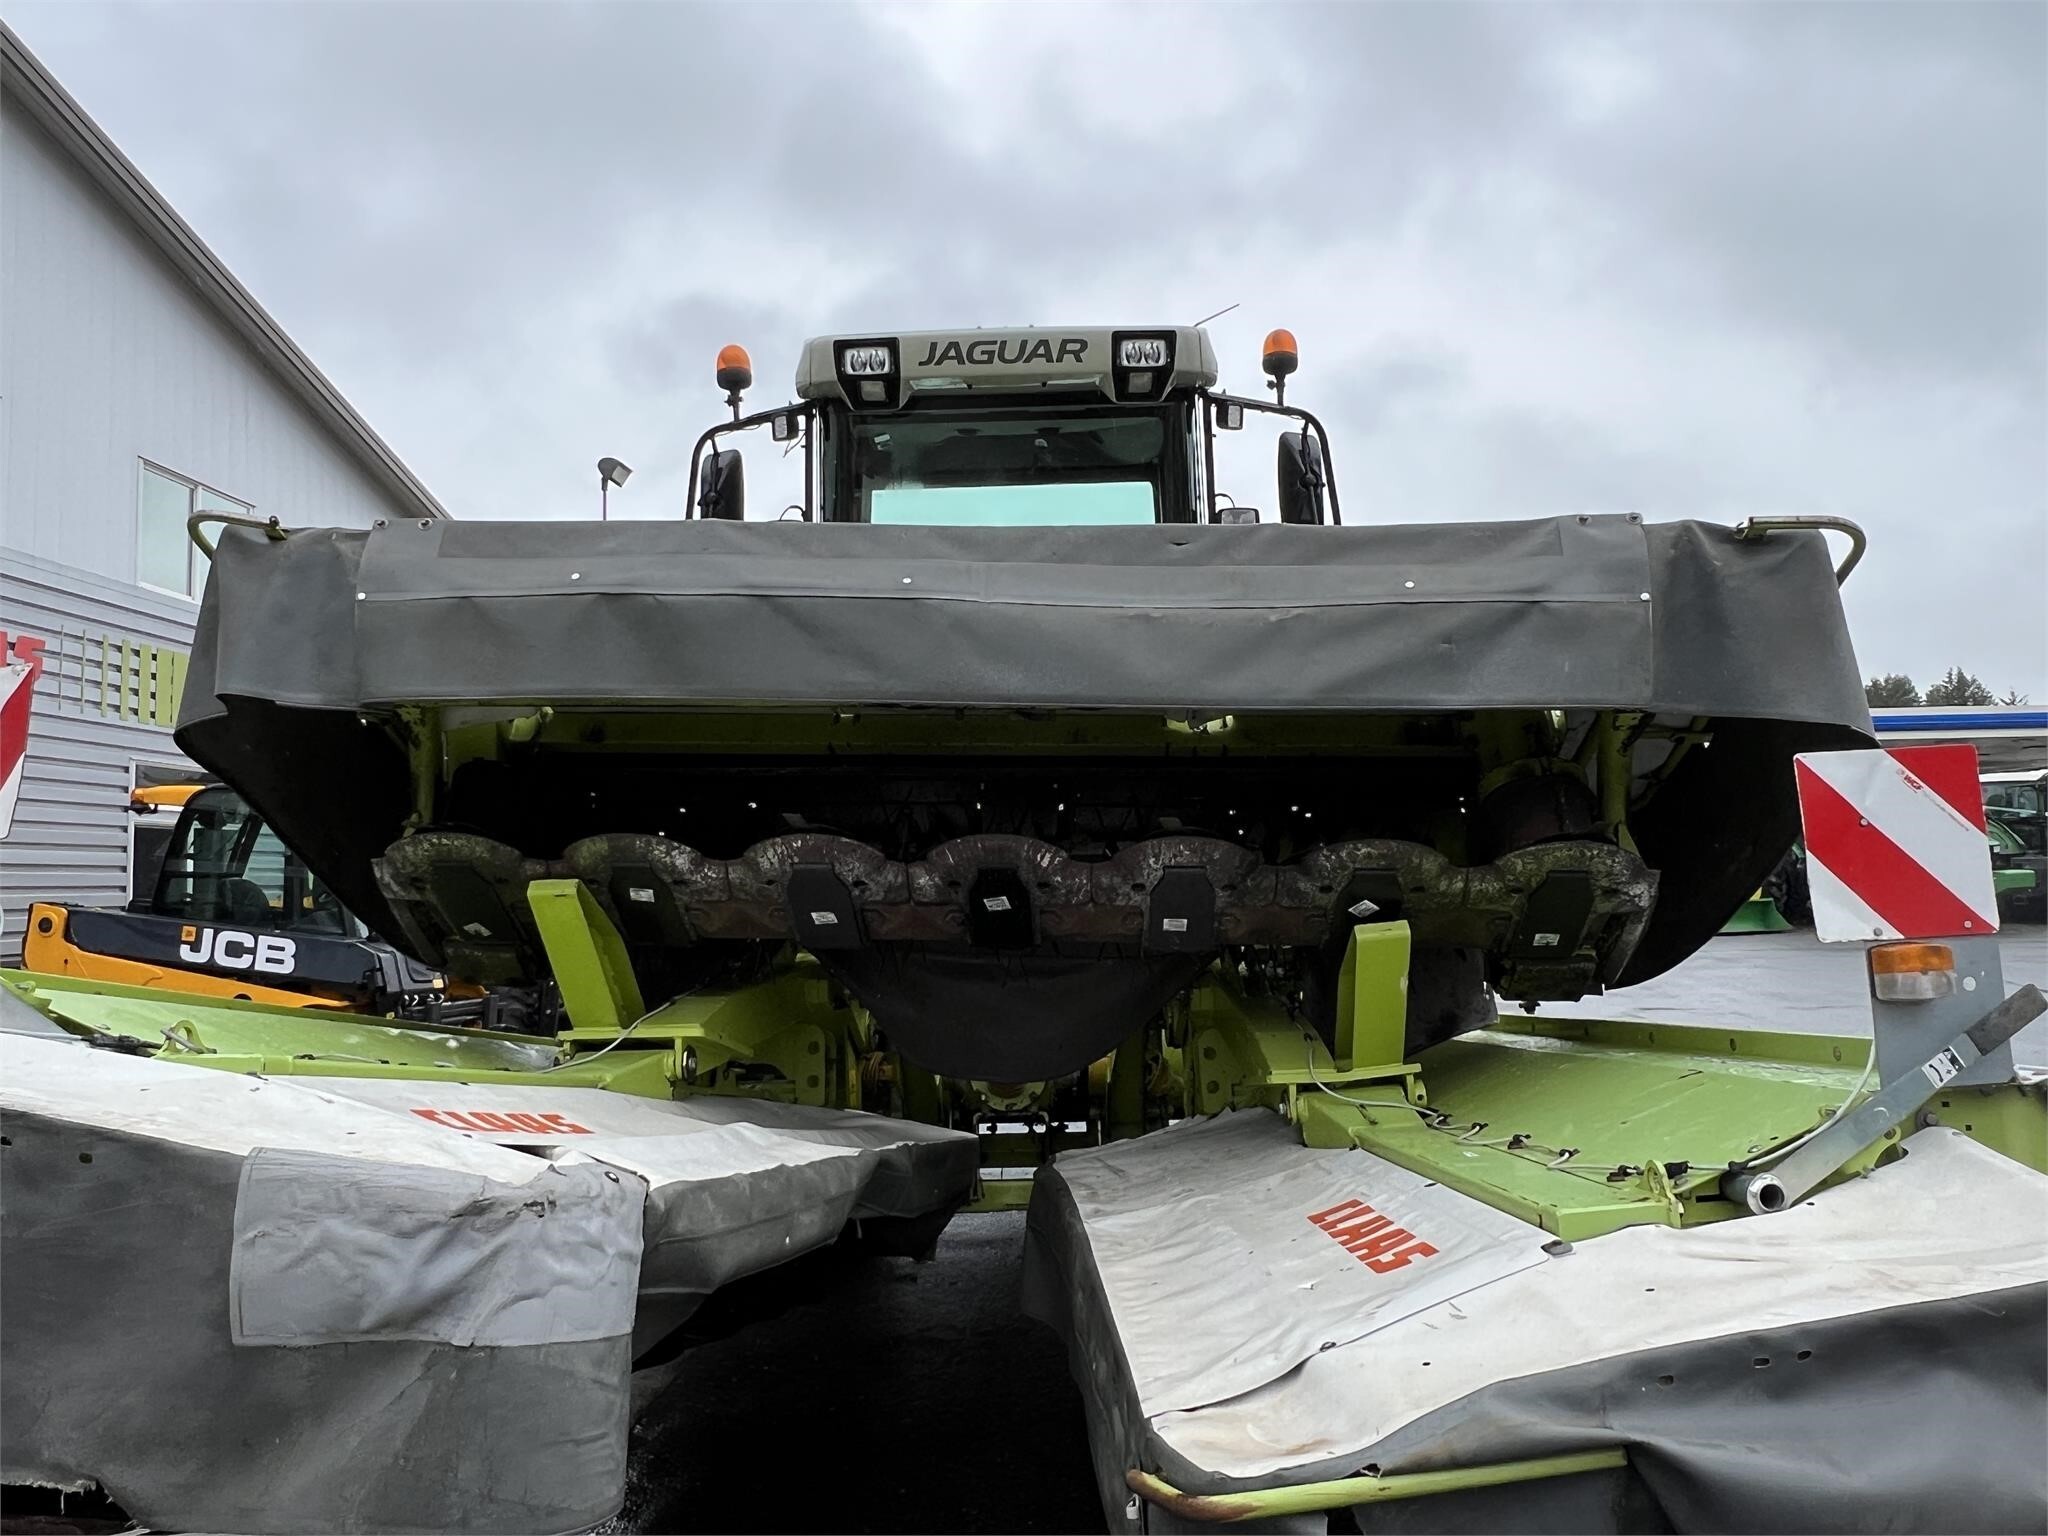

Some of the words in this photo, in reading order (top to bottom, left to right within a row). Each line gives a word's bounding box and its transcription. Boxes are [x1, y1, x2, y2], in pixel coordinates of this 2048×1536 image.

[918, 338, 1089, 367] JAGUAR
[180, 927, 297, 974] JCB
[409, 1109, 596, 1134] CLAAS
[1306, 1199, 1440, 1274] CLAAS
